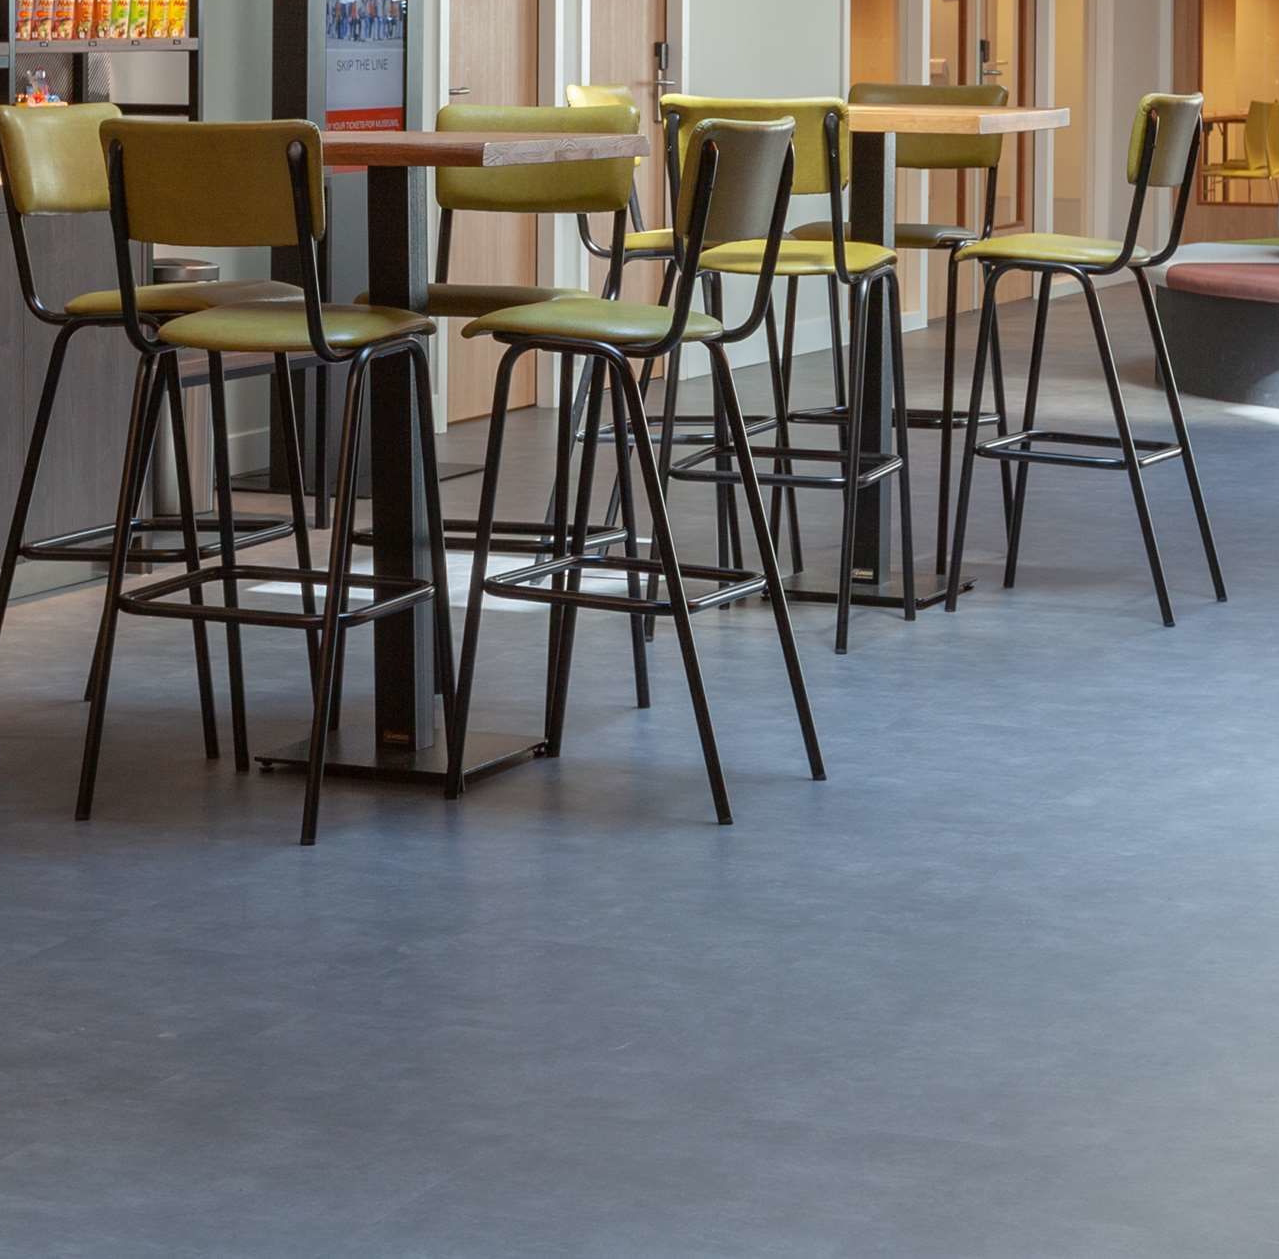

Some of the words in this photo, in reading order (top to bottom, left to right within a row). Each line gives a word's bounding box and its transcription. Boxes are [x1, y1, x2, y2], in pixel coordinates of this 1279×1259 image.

[337, 60, 354, 72] SKIP
[356, 59, 370, 71] THE
[372, 58, 388, 70] LINE
